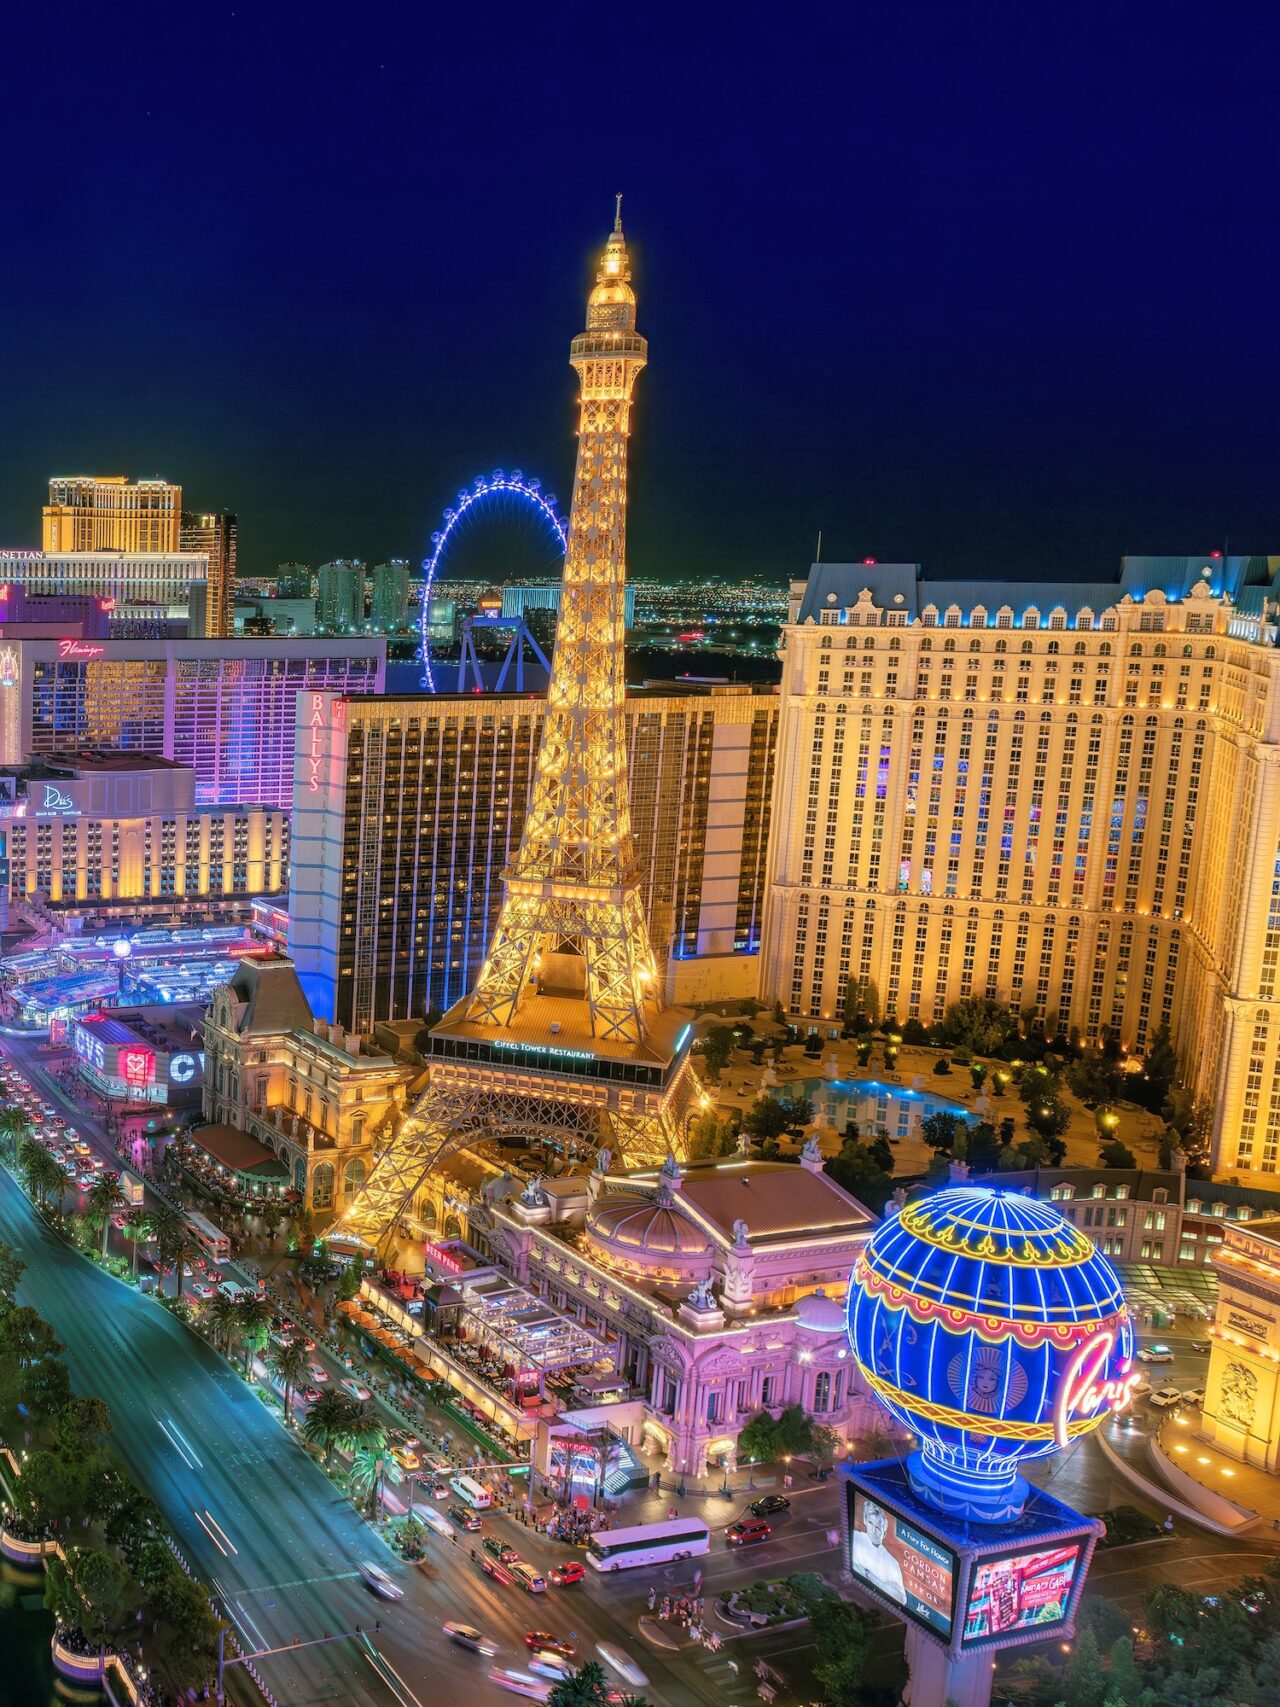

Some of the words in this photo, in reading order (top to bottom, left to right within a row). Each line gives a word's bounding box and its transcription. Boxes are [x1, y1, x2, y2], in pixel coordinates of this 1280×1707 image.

[59, 640, 104, 656] Flamingo
[75, 1026, 105, 1070] CVS
[494, 1040, 519, 1050] EIFFEL
[520, 1043, 548, 1054] TOWER
[549, 1047, 596, 1060] RESTAURANT
[426, 1242, 442, 1262] BEER
[442, 1254, 461, 1275] PARK
[1059, 1332, 1142, 1448] Paris
[906, 1531, 920, 1546] Fury
[920, 1539, 931, 1552] For
[903, 1549, 947, 1585] GORDON
[903, 1559, 946, 1594] RAMSAY
